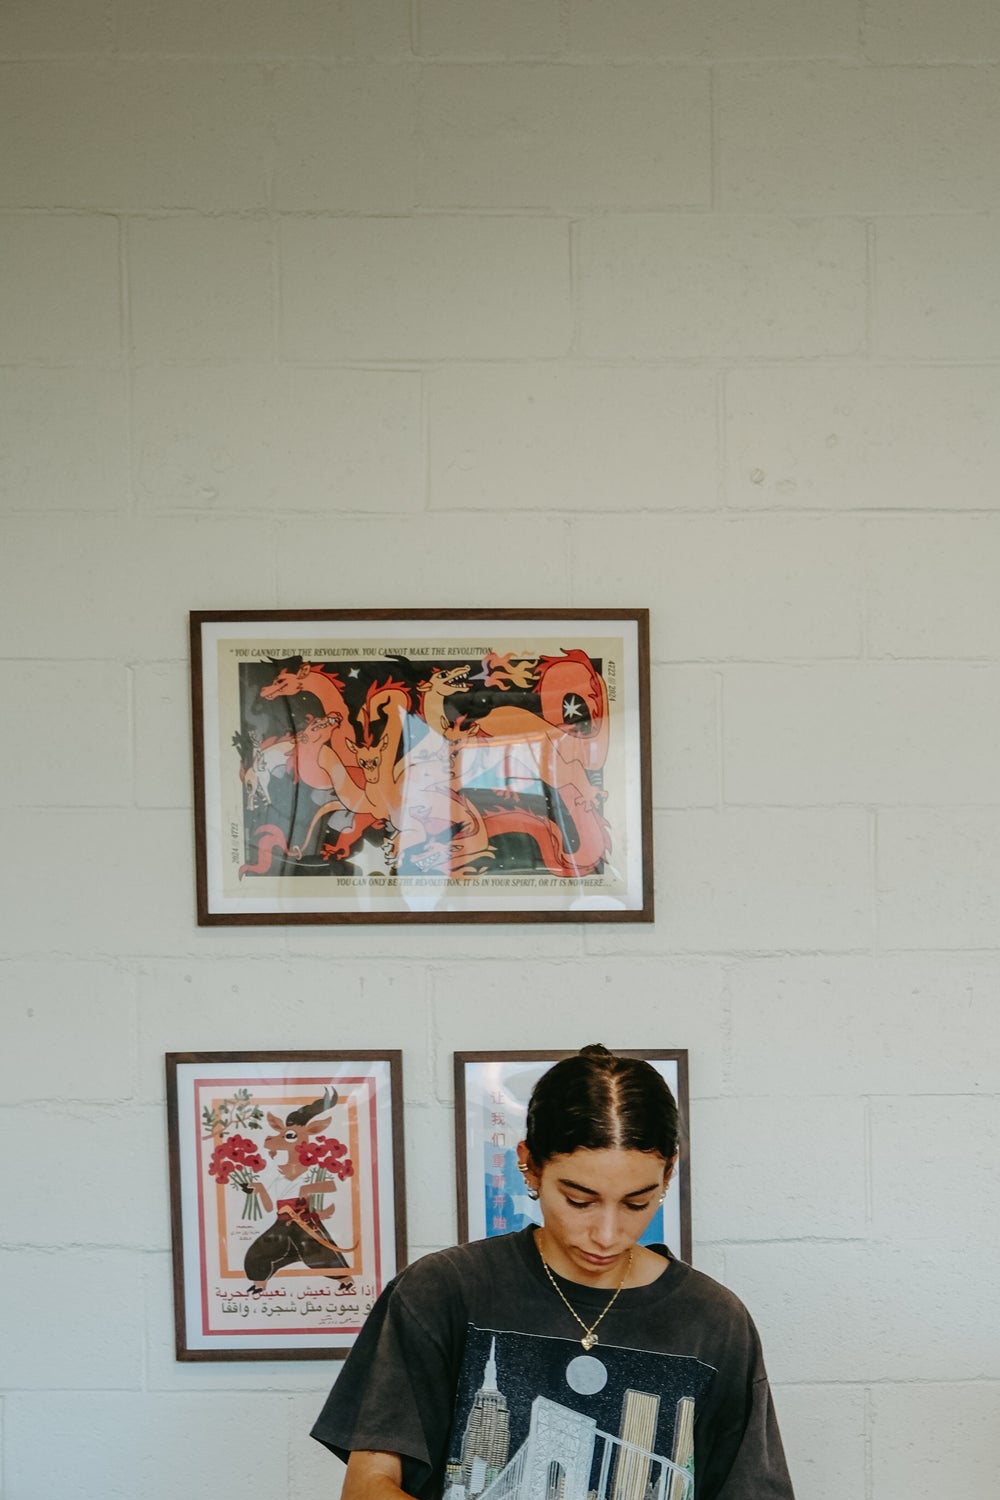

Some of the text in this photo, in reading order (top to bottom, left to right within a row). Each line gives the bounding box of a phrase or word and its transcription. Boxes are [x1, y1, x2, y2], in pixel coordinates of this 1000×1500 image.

[250, 648, 280, 657] CANNOT
[281, 648, 297, 657] BUY
[298, 648, 312, 657] THE
[362, 647, 378, 656] YOU
[378, 647, 408, 656] CANNOT
[409, 647, 429, 656] MAKE
[431, 647, 445, 656] THE
[336, 878, 352, 887] YOU
[352, 878, 368, 887] CAN
[369, 878, 386, 887] ONLY
[387, 878, 398, 887] BE
[472, 878, 480, 887] IS
[481, 878, 489, 887] IN
[490, 878, 510, 887] YOUR
[538, 878, 549, 887] OR
[297, 1285, 331, 1300] تعيش
[361, 1285, 375, 1299] إذا
[261, 1300, 297, 1317] شجرة
